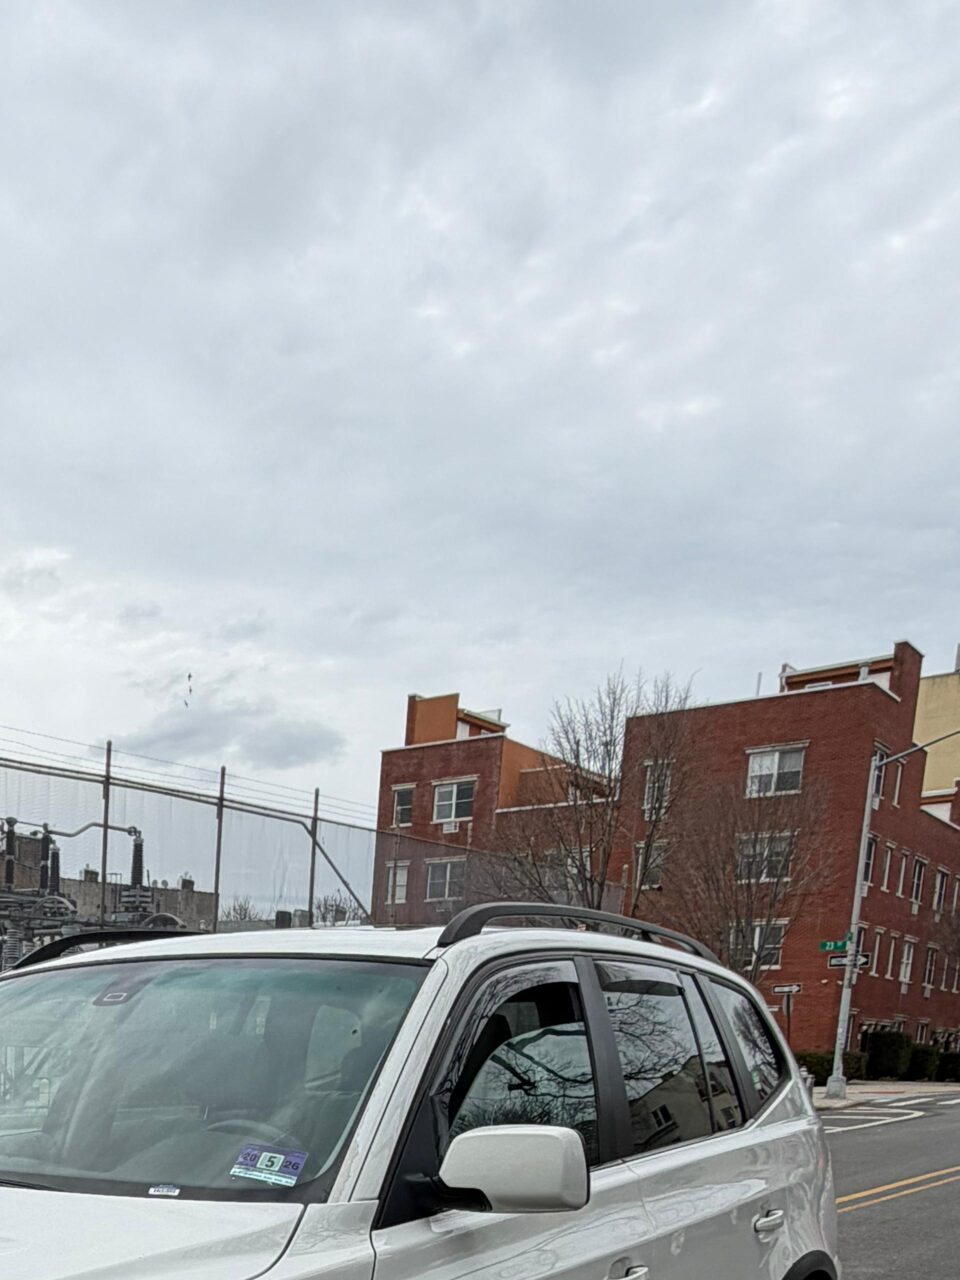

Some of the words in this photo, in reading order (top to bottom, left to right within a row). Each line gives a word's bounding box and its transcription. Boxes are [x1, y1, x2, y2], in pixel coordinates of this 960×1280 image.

[826, 942, 834, 951] 23
[242, 1152, 258, 1162] 20
[264, 1155, 277, 1169] 5
[283, 1160, 300, 1171] 26
